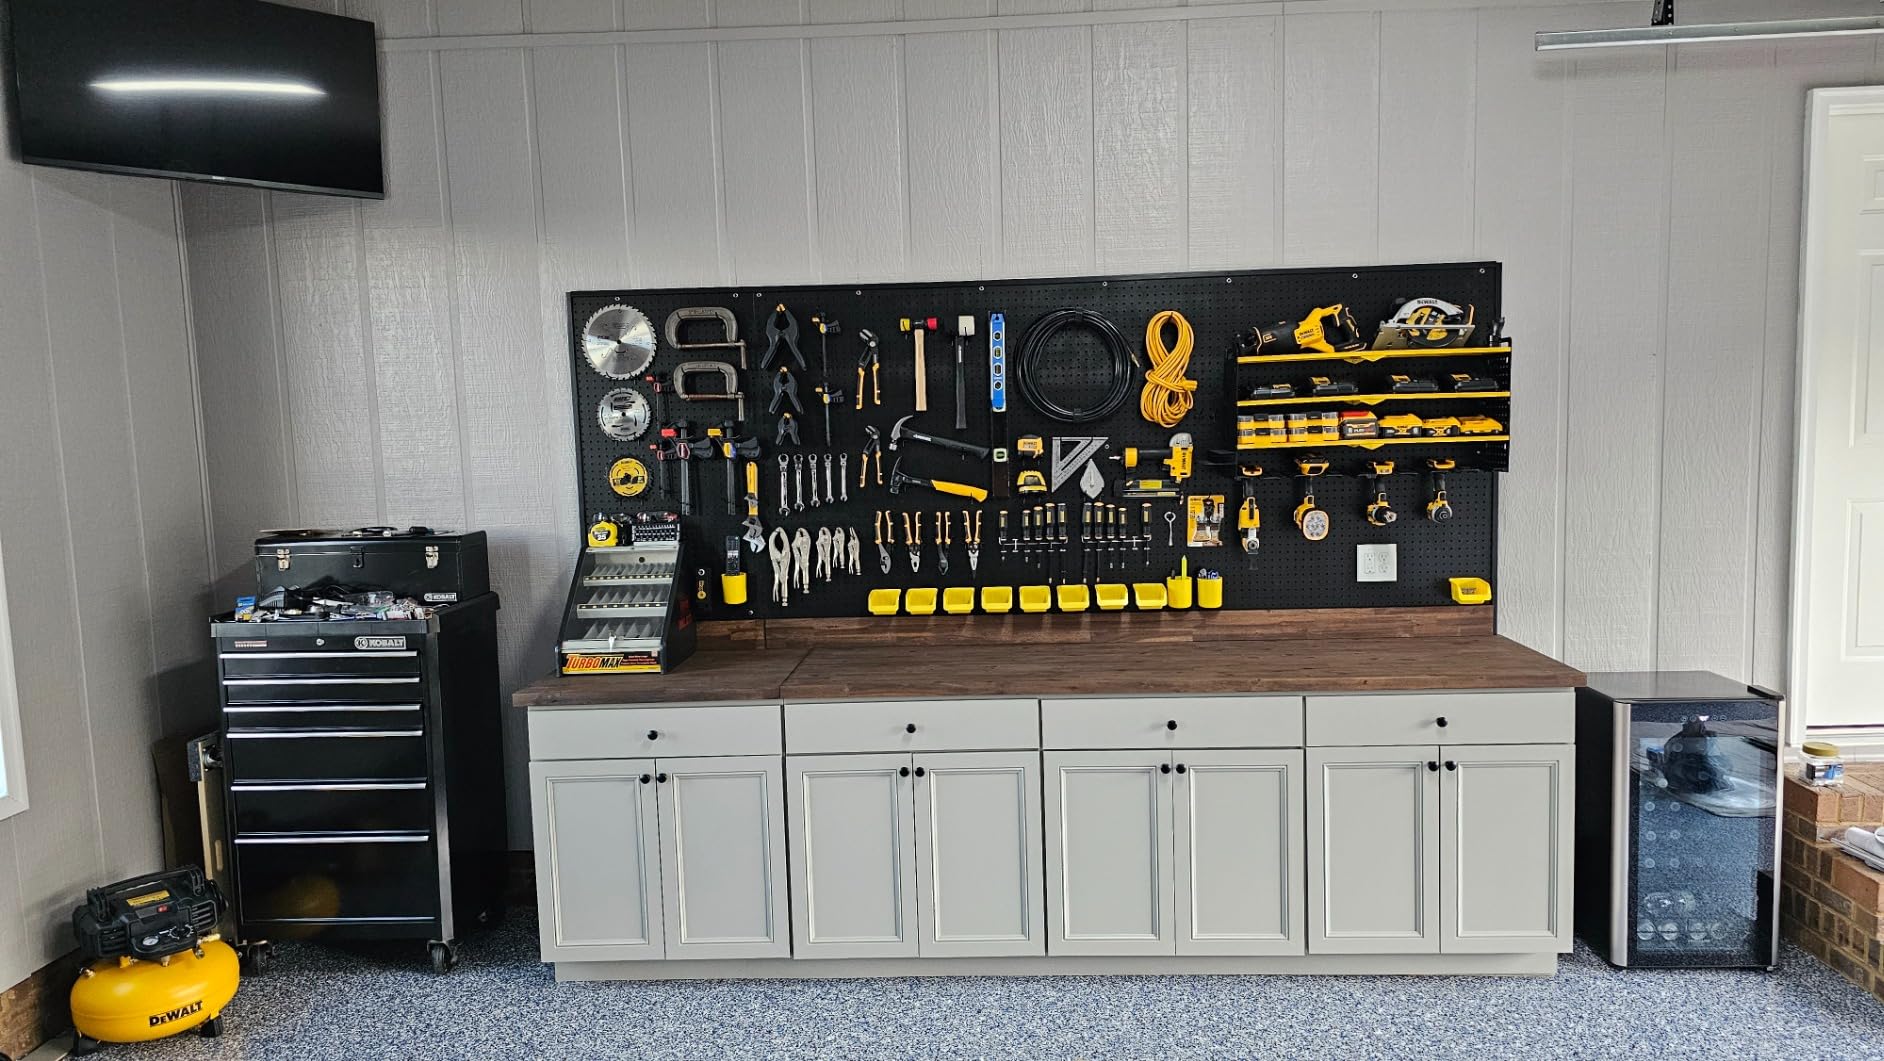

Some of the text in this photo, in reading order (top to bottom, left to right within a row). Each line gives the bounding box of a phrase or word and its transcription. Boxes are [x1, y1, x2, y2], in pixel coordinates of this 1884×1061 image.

[369, 638, 403, 647] KOBALT
[566, 654, 623, 668] TURBOMAX
[149, 1000, 203, 1027] DEWALT
